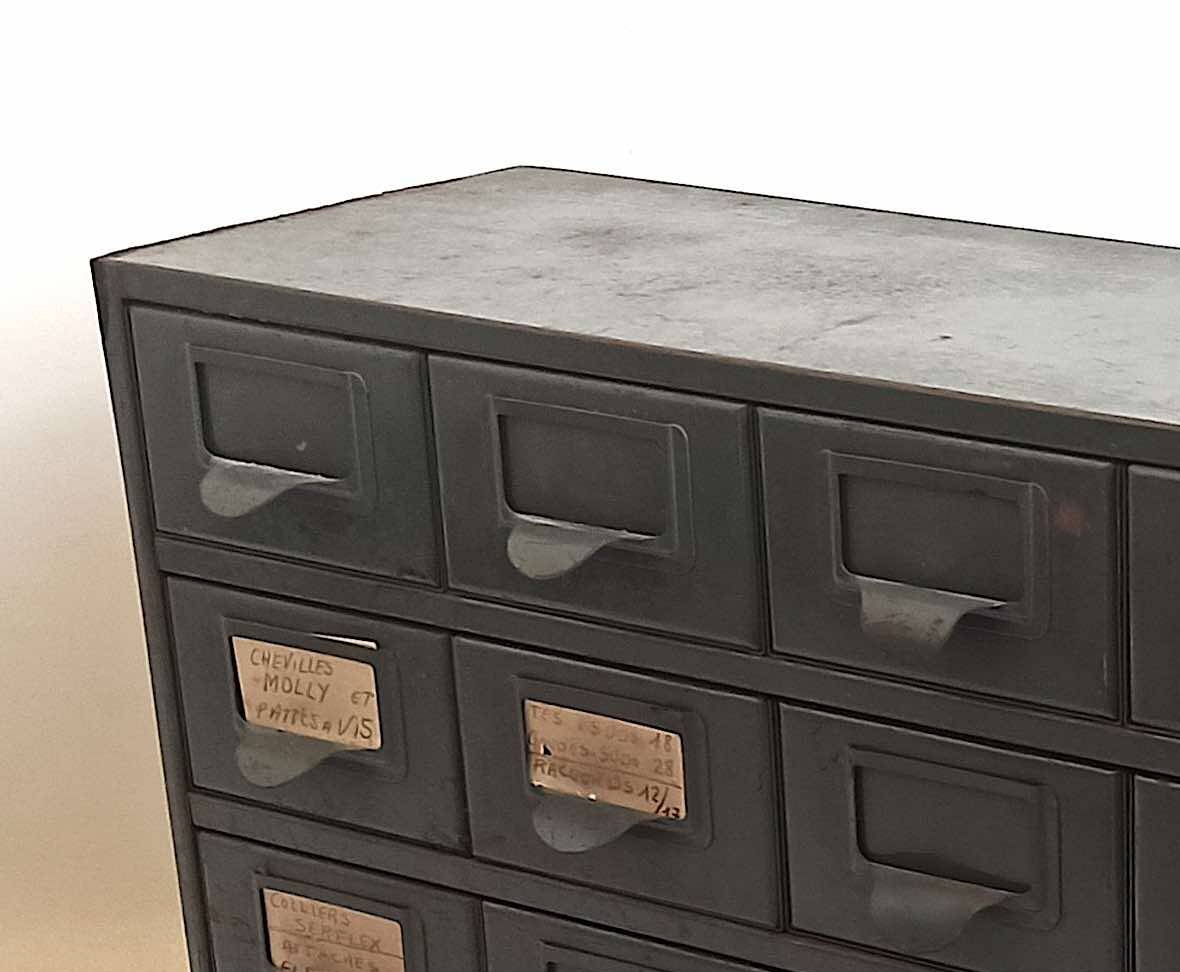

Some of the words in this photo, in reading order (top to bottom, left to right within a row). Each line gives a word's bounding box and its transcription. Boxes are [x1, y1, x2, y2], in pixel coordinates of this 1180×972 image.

[250, 647, 334, 676] CHEVILLES
[264, 673, 331, 703] MOLLY
[351, 691, 375, 708] ET
[650, 731, 673, 753] 18
[653, 758, 676, 777] 28
